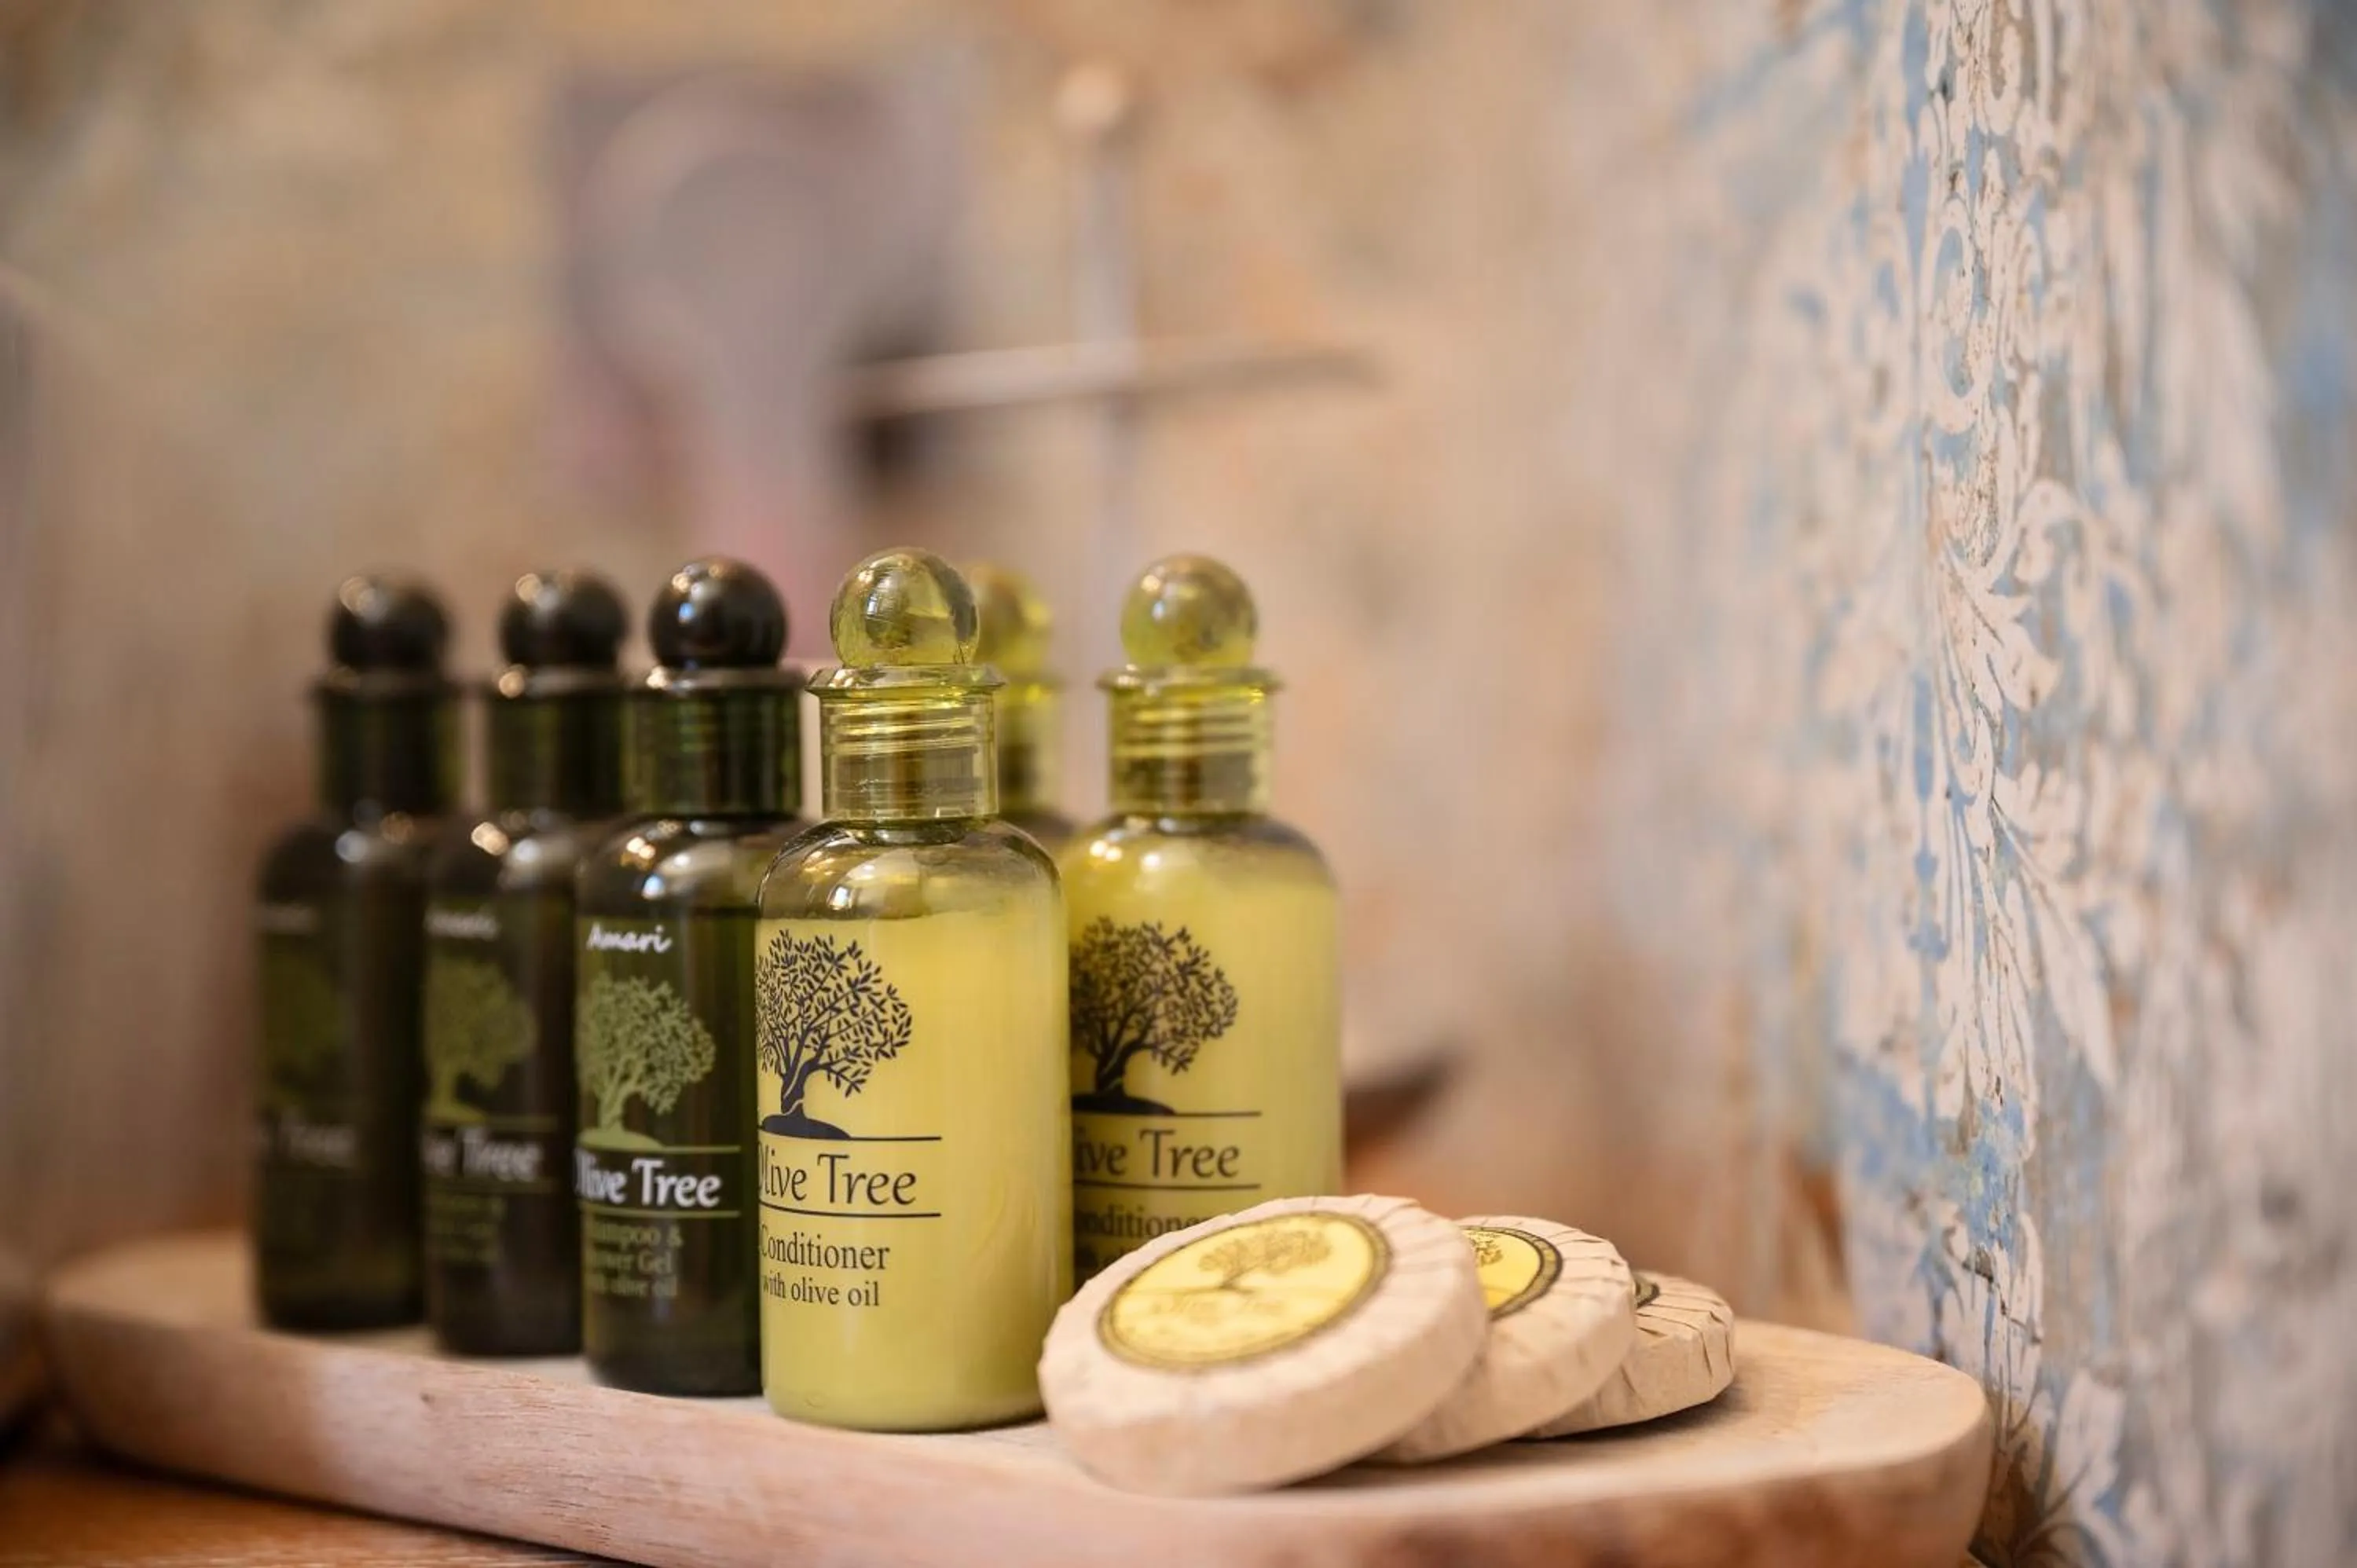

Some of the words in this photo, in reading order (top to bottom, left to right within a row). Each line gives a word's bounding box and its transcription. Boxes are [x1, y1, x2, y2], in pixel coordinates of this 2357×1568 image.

[1139, 1129, 1240, 1178] Tree
[631, 1158, 723, 1207] Tree
[817, 1153, 916, 1205] Tree
[790, 1277, 840, 1305] olive
[848, 1281, 880, 1306] oil
